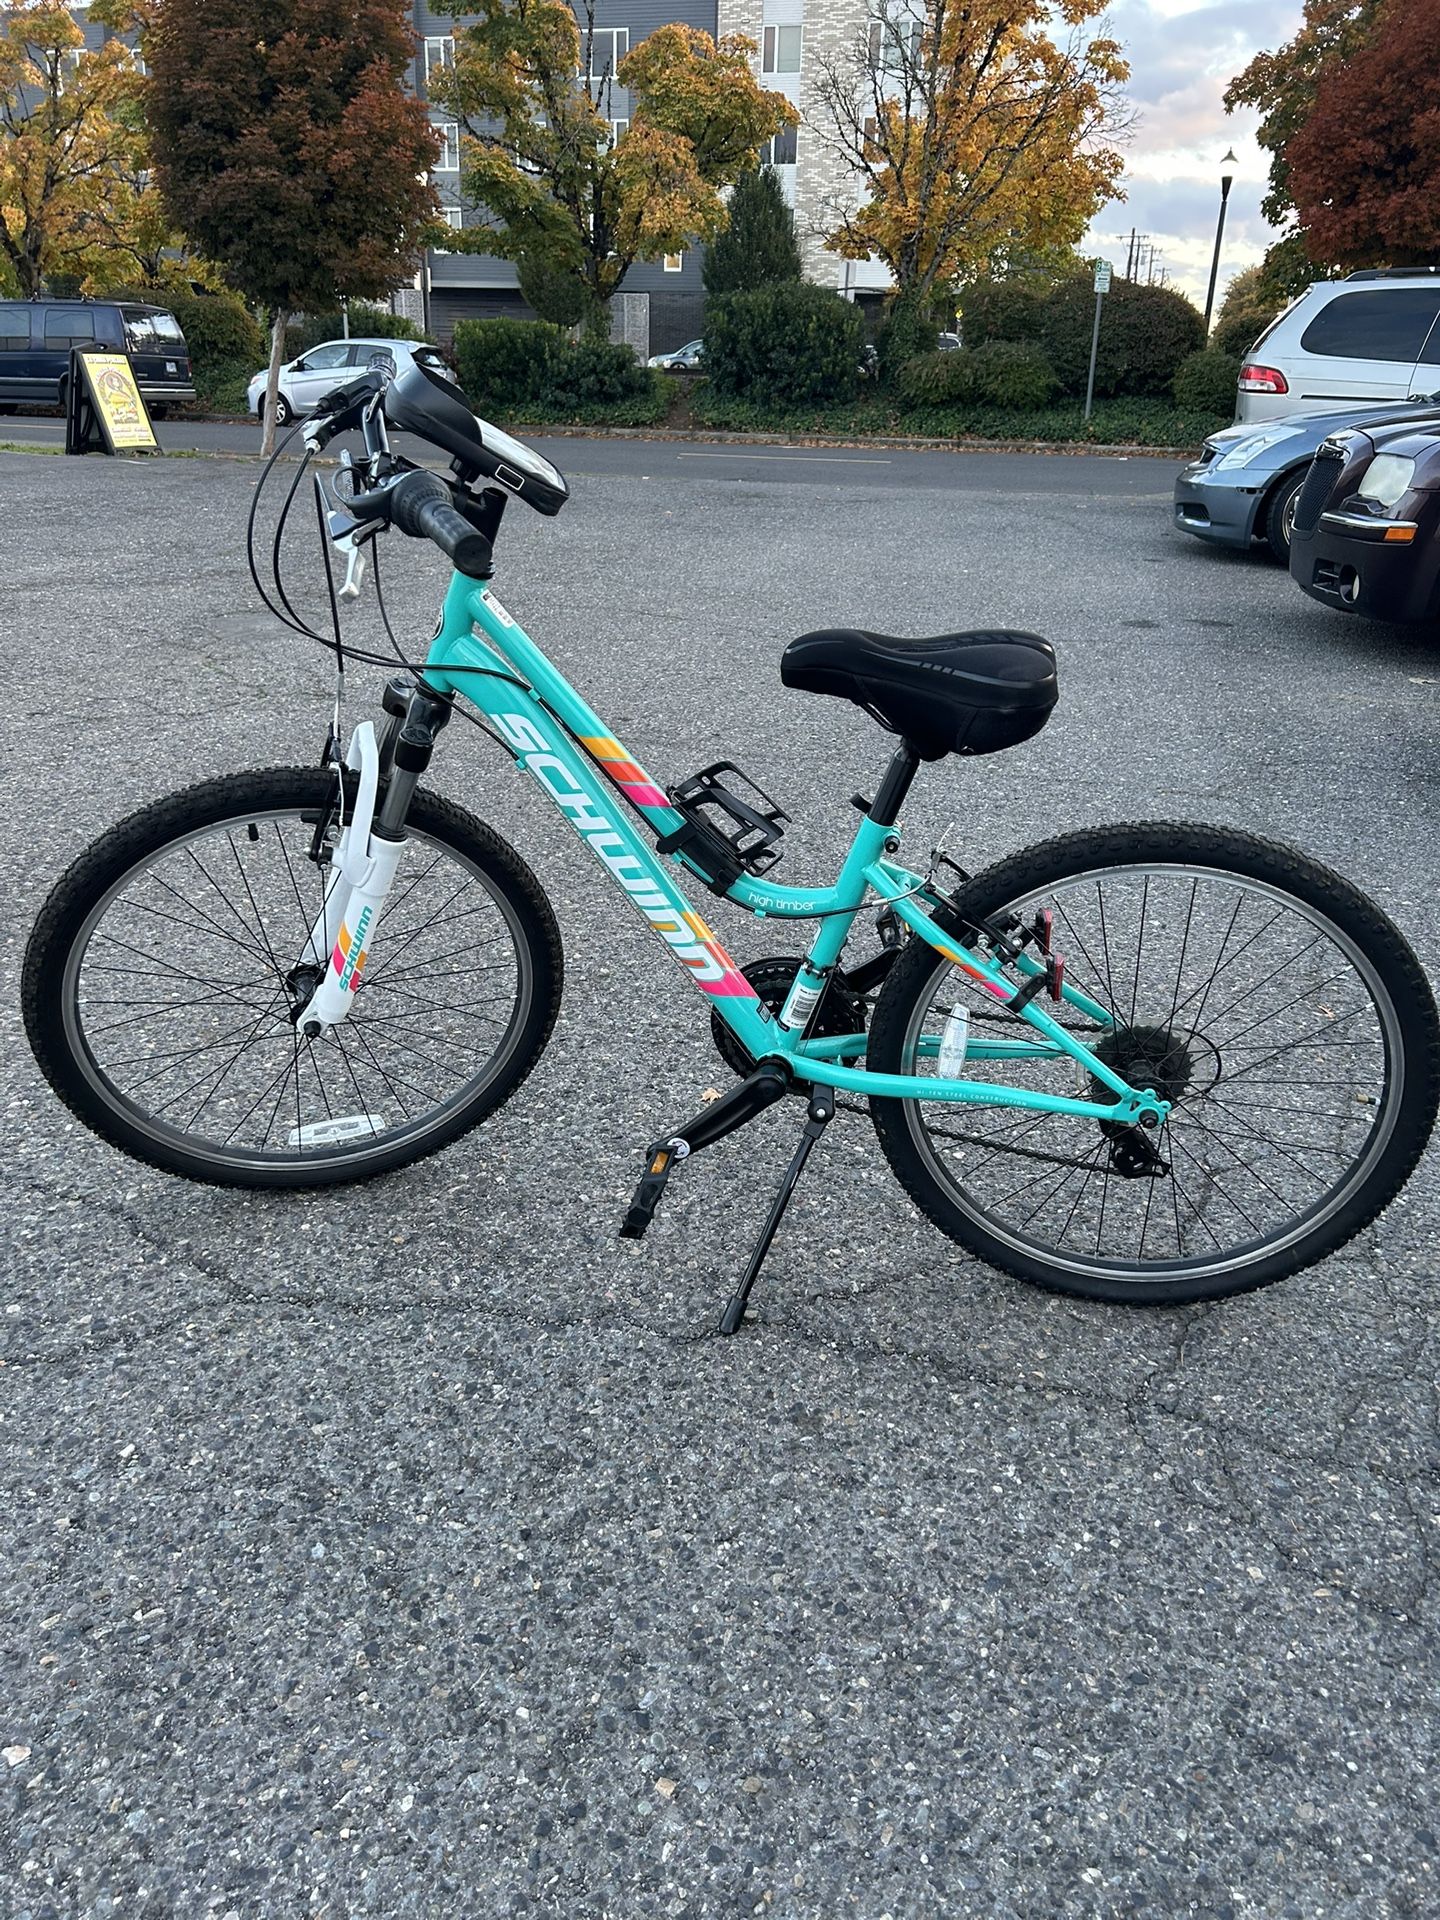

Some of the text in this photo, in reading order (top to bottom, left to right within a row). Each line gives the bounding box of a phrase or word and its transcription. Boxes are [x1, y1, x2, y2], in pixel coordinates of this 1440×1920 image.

[489, 713, 724, 982] SCHWINN
[748, 892, 817, 911] high timber
[339, 905, 373, 992] SCHWINN
[945, 1091, 967, 1099] STEEL
[970, 1094, 1027, 1106] CONSTRUCTION
